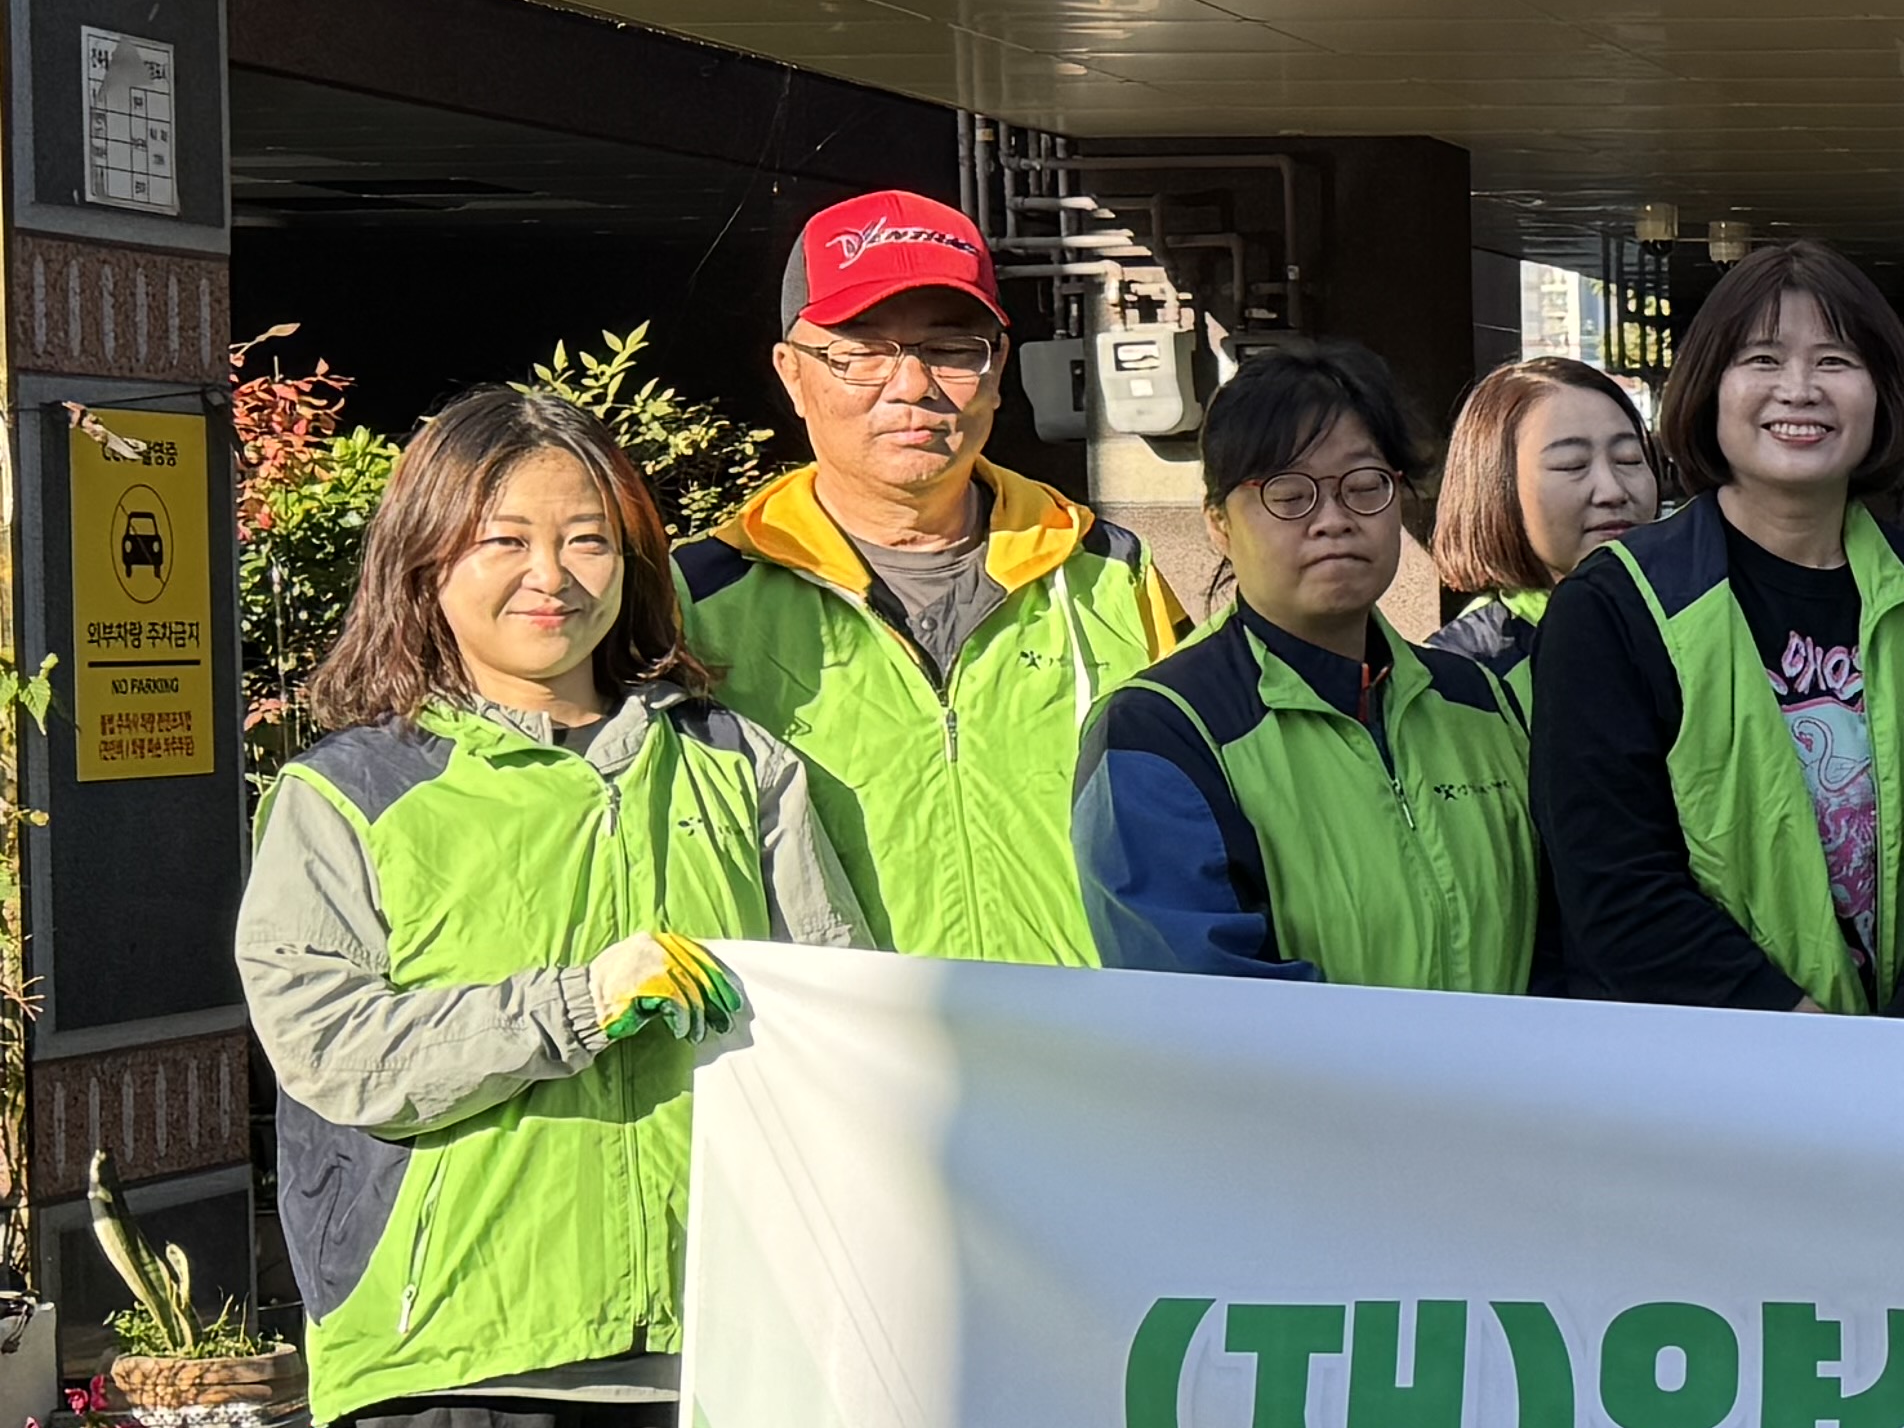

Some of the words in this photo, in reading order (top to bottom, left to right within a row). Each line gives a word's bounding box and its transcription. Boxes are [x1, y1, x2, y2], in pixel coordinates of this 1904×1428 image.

[87, 621, 143, 649] 외부차량
[146, 621, 200, 649] 주차금지
[112, 678, 128, 695] NO
[130, 677, 179, 694] PARKING
